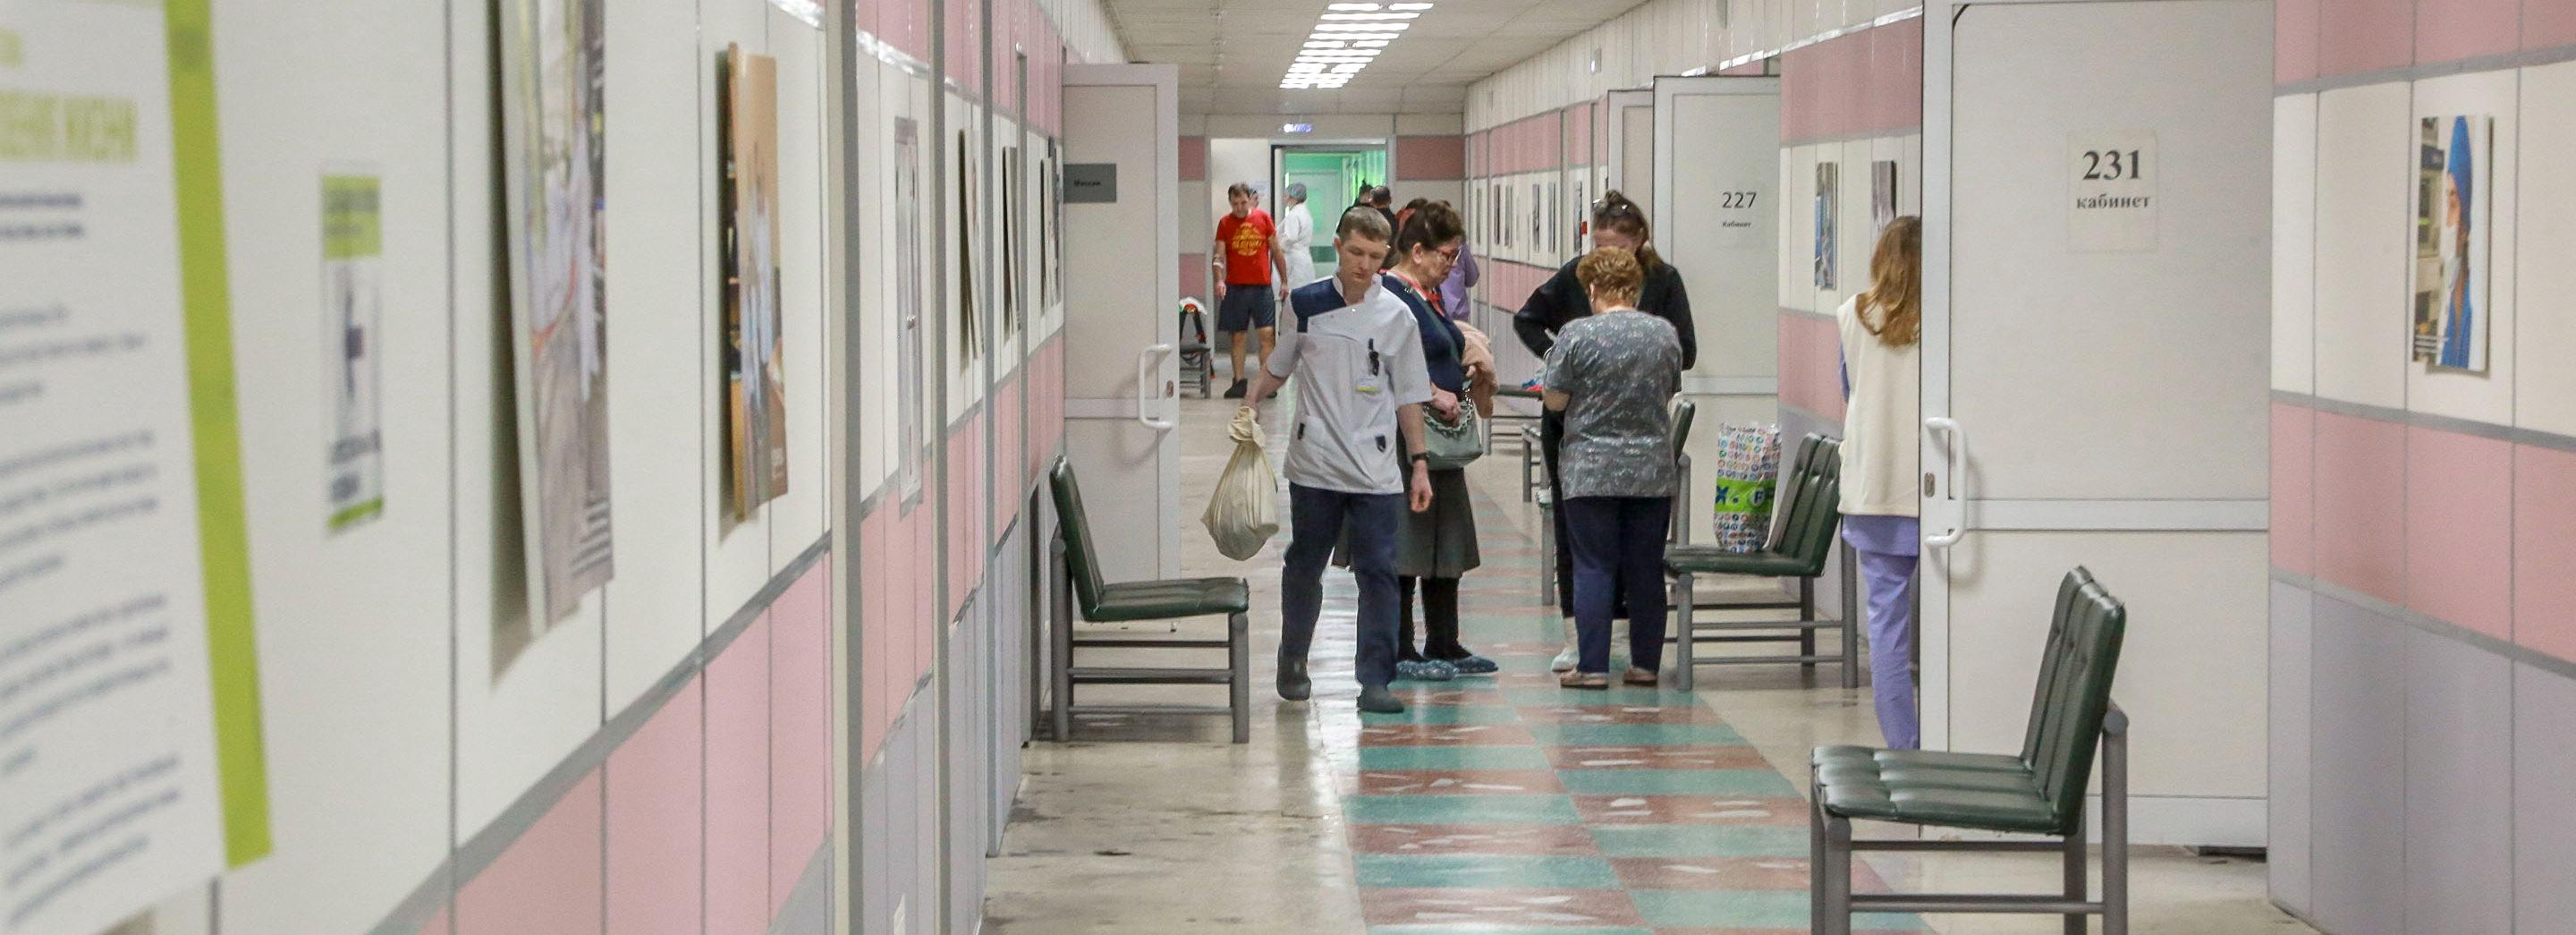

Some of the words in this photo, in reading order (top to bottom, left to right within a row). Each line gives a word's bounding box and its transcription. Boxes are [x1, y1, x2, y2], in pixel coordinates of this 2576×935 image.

[2082, 149, 2140, 181] 231
[1723, 191, 1757, 208] 227
[2076, 193, 2150, 208] кабинет
